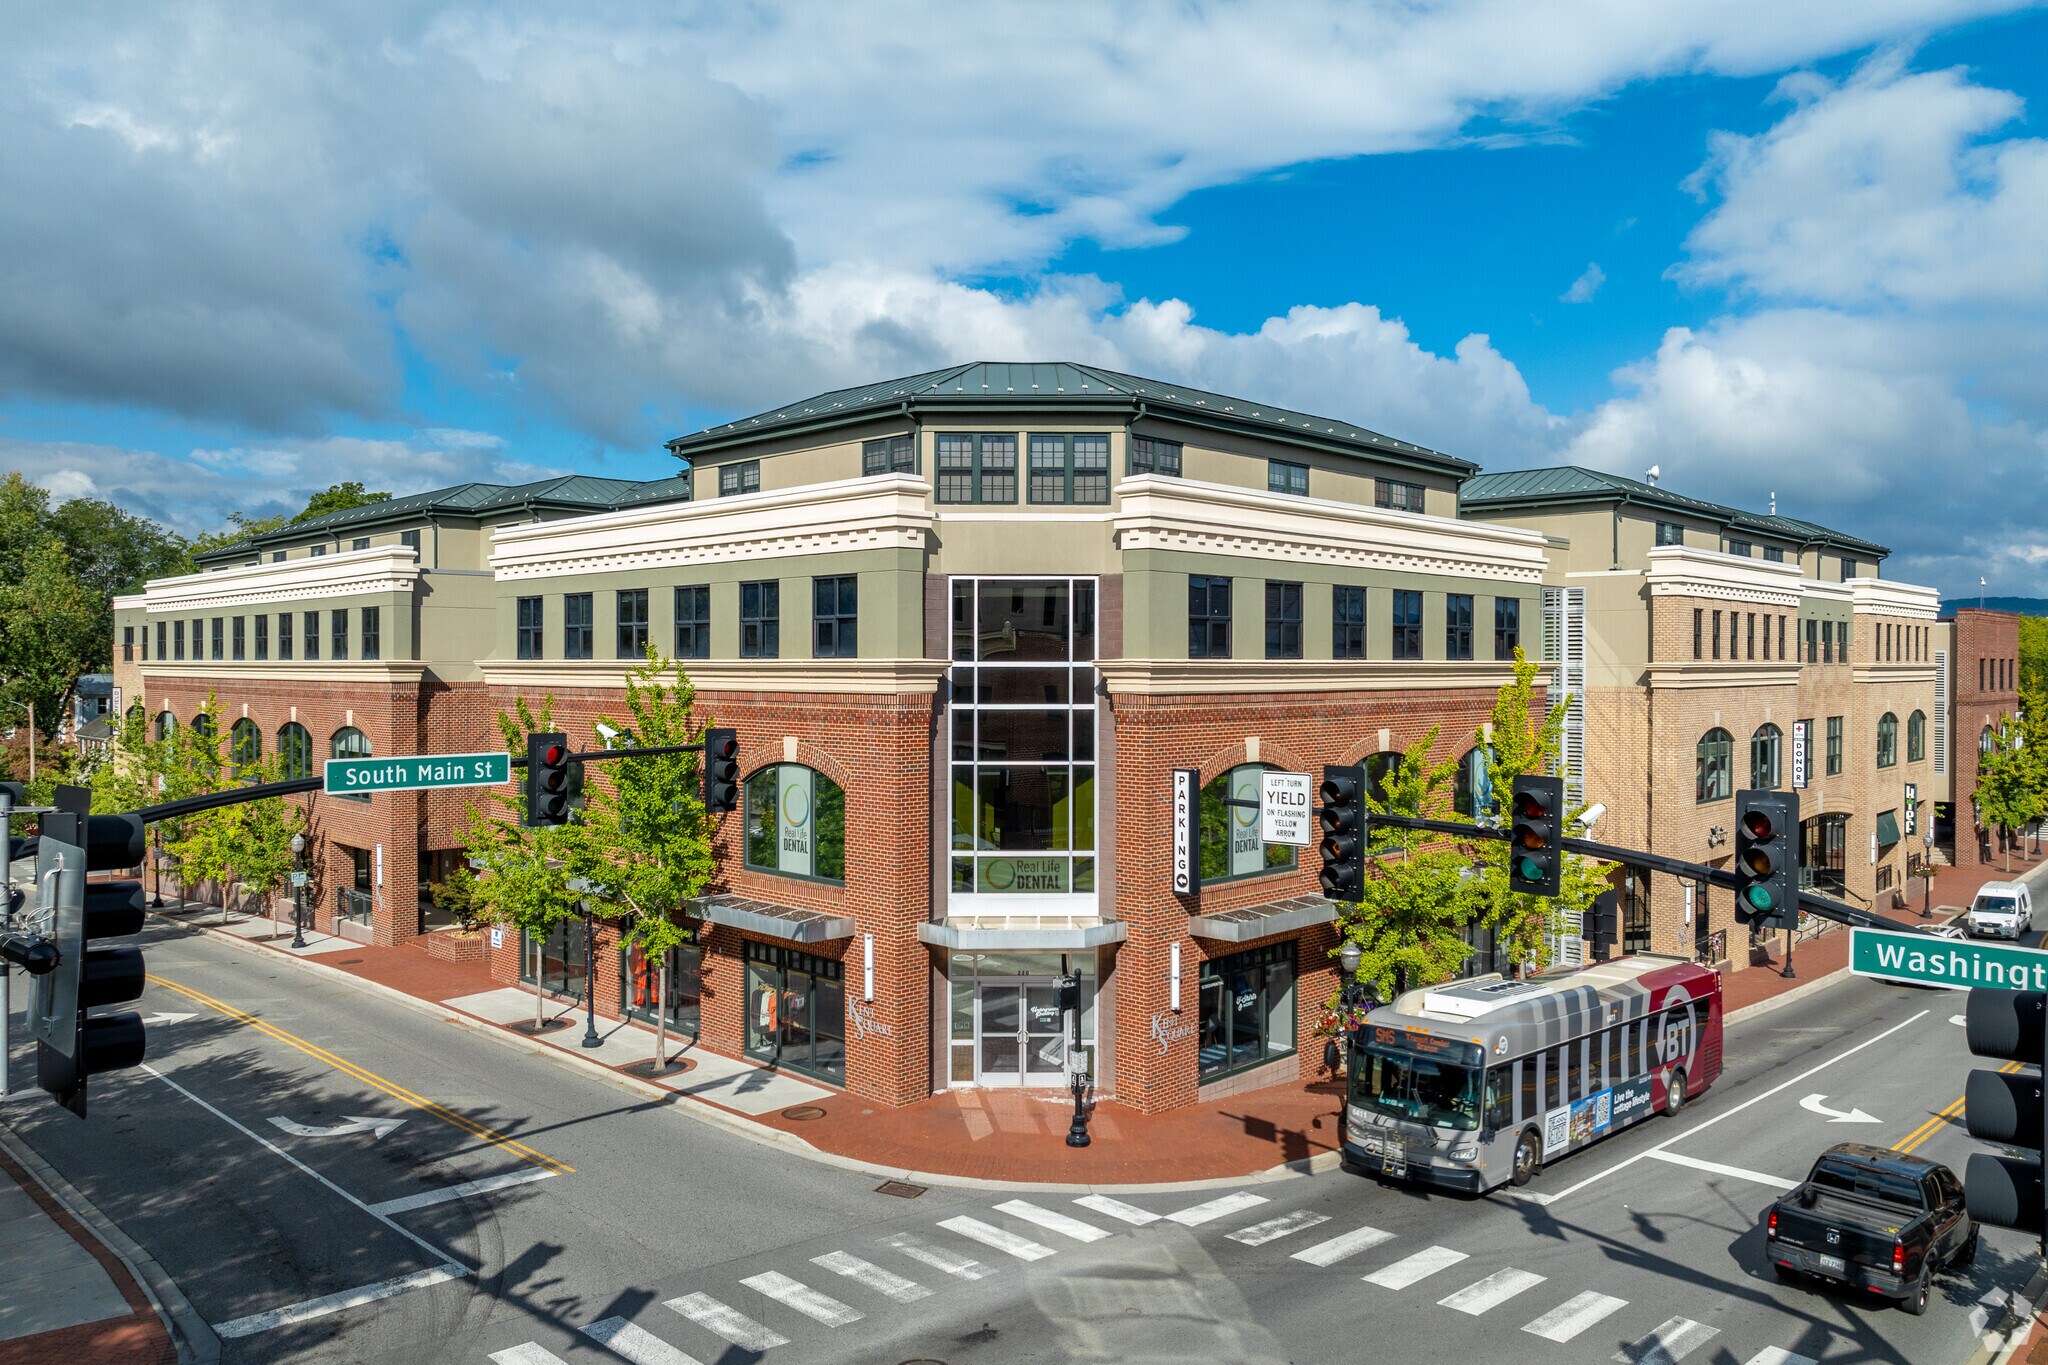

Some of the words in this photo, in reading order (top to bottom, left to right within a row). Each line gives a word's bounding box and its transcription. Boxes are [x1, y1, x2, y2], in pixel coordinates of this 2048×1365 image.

[1795, 742, 1803, 780] DONOR
[345, 765, 407, 786] South
[418, 762, 465, 782] Main
[474, 761, 493, 779] St
[1271, 779, 1285, 787] LEFT
[1286, 780, 1303, 788] TURN
[1267, 791, 1306, 806] YIELD
[1267, 808, 1275, 816] ON
[1277, 810, 1306, 819] FLASHING
[1178, 775, 1186, 870] PARKING
[1274, 819, 1298, 828] YELLOW
[784, 826, 797, 838] Real
[1236, 829, 1248, 840] Real
[1248, 826, 1259, 838] Life
[1275, 829, 1296, 838] ARROW
[783, 838, 808, 854] DENTAL
[1235, 838, 1259, 854] DENTAL
[1016, 860, 1039, 873] Real
[1042, 859, 1061, 873] Life
[1016, 875, 1061, 890] DENTAL
[1876, 942, 2046, 990] Washingt
[1151, 1010, 1180, 1040] KENT
[1158, 1024, 1197, 1056] SQUARE
[1375, 1027, 1396, 1046] SMS
[1666, 1018, 1690, 1063] BT
[1613, 1099, 1632, 1115] cottage
[1632, 1091, 1650, 1107] lifestyle
[1614, 1092, 1626, 1105] Live
[1625, 1088, 1635, 1101] the
